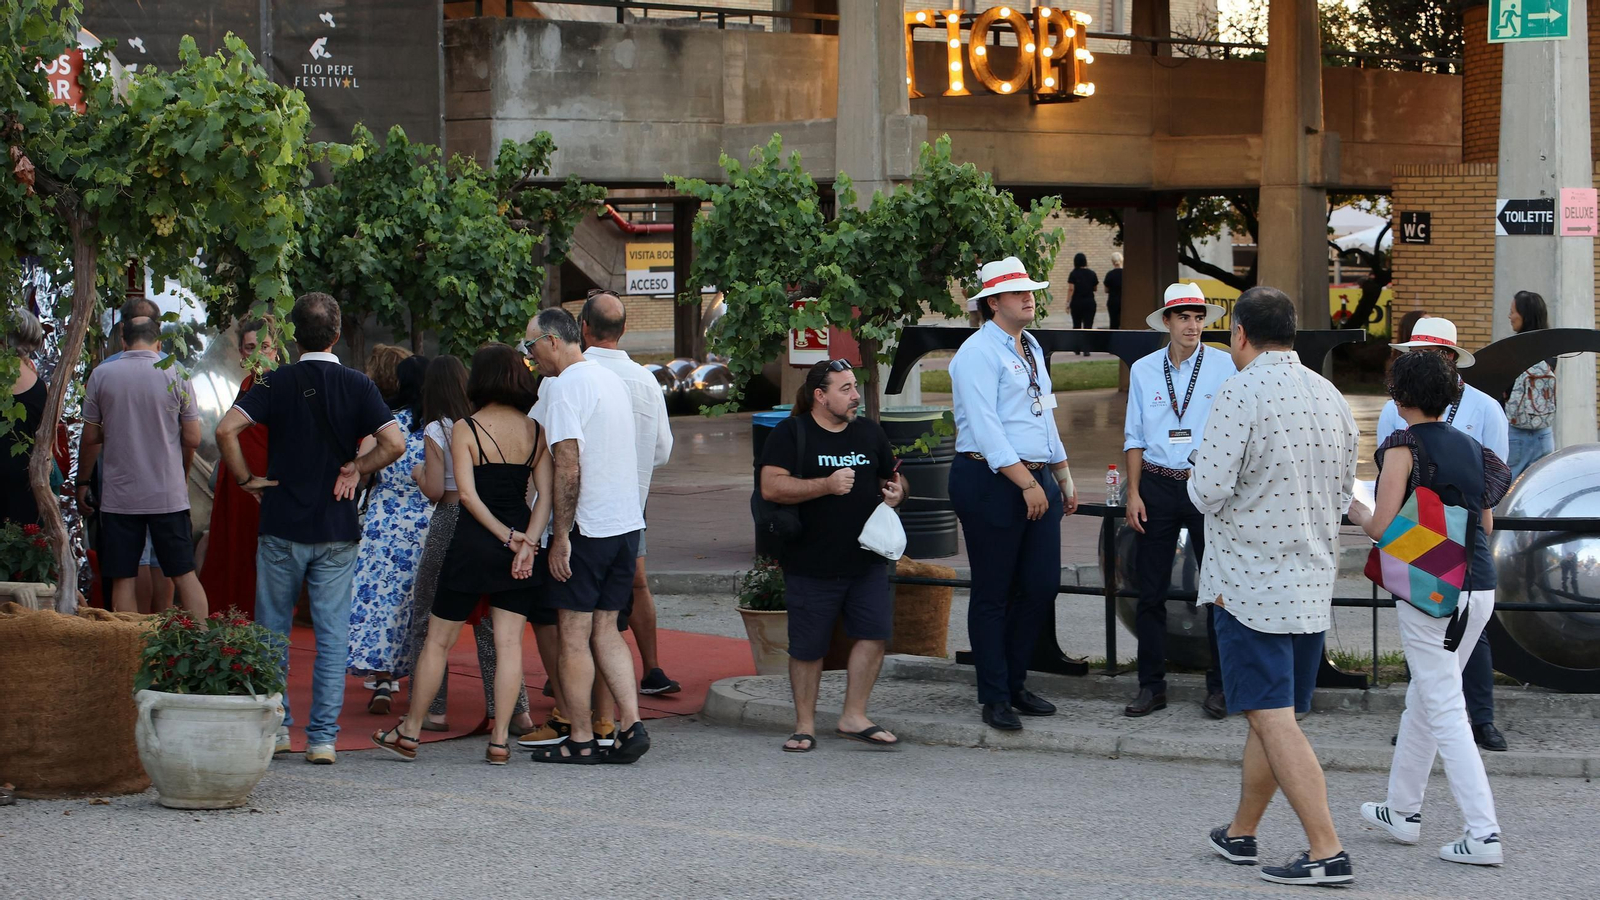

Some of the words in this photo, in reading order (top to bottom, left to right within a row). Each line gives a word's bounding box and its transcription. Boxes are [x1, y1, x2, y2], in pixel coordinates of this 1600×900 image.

[301, 63, 322, 75] TIO
[327, 64, 354, 76] PEPE
[1504, 210, 1554, 223] TOILETTE
[1564, 206, 1594, 219] DELUXE
[1403, 223, 1426, 238] WC
[629, 250, 656, 260] VISITA
[630, 278, 669, 291] ACCESO
[818, 451, 870, 467] music.
